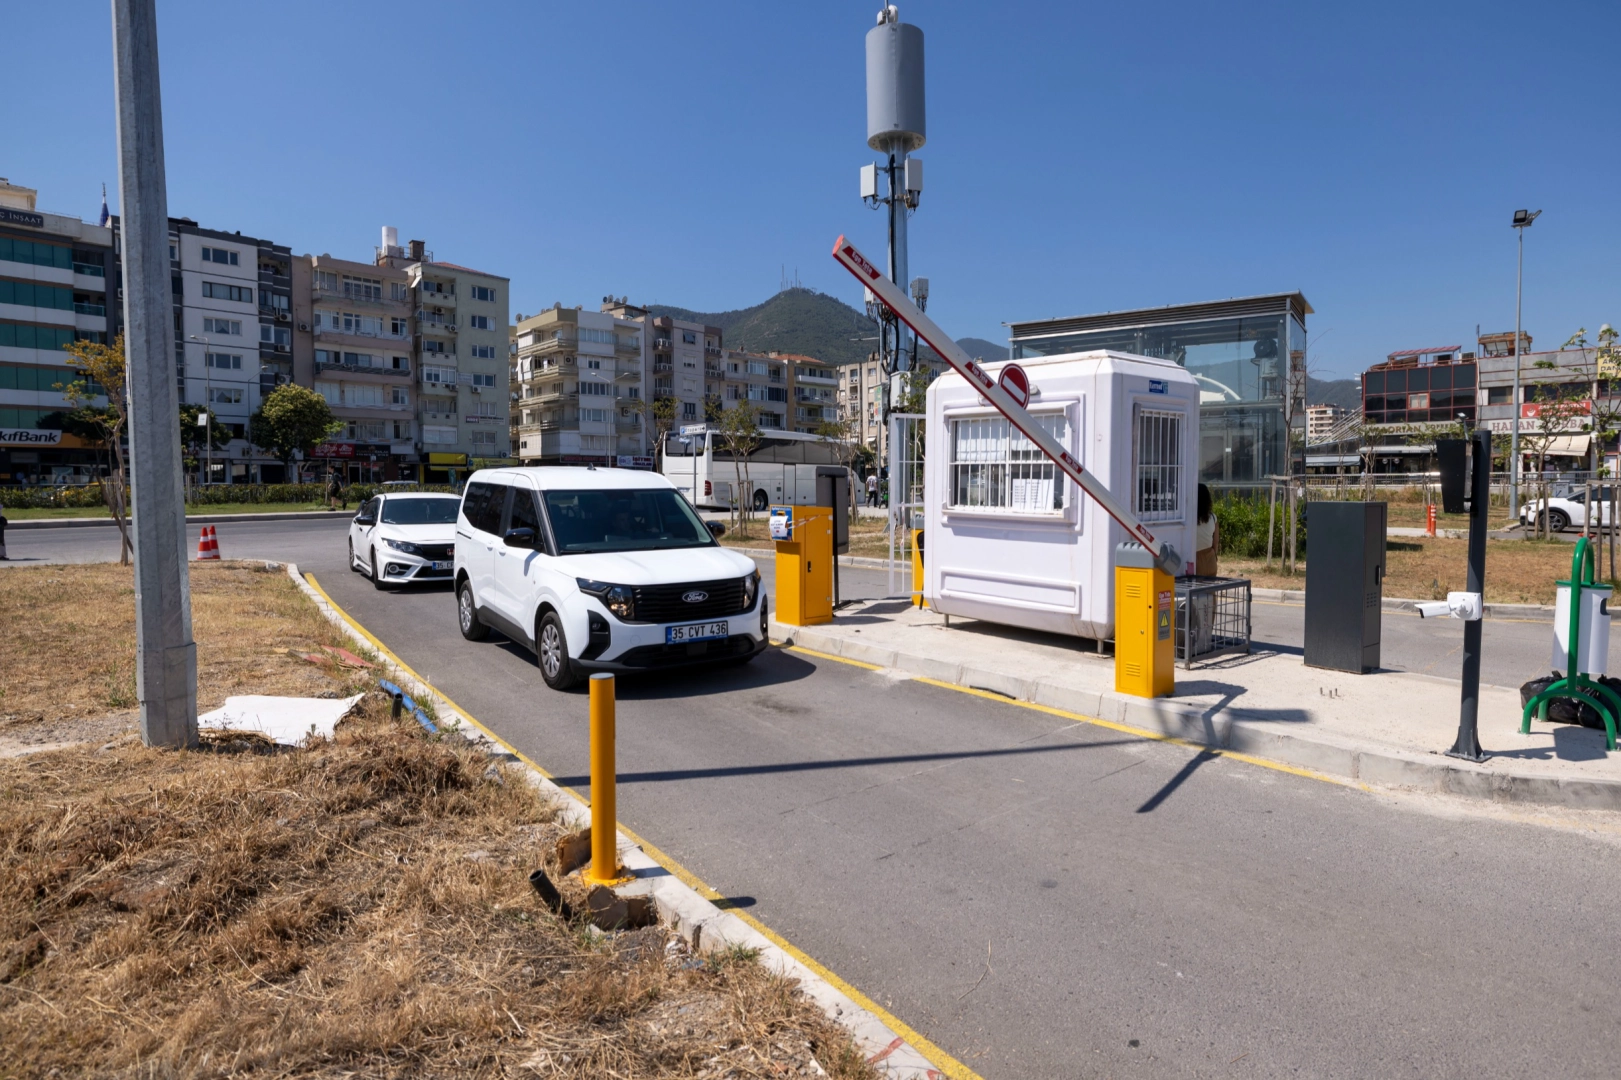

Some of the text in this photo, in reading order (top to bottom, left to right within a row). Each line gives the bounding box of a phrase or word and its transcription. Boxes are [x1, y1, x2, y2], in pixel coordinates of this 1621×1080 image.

[0, 431, 57, 442] kıfBank
[688, 592, 703, 601] Ford
[672, 627, 684, 639] 35
[688, 625, 706, 638] CVT
[709, 623, 726, 635] 436
